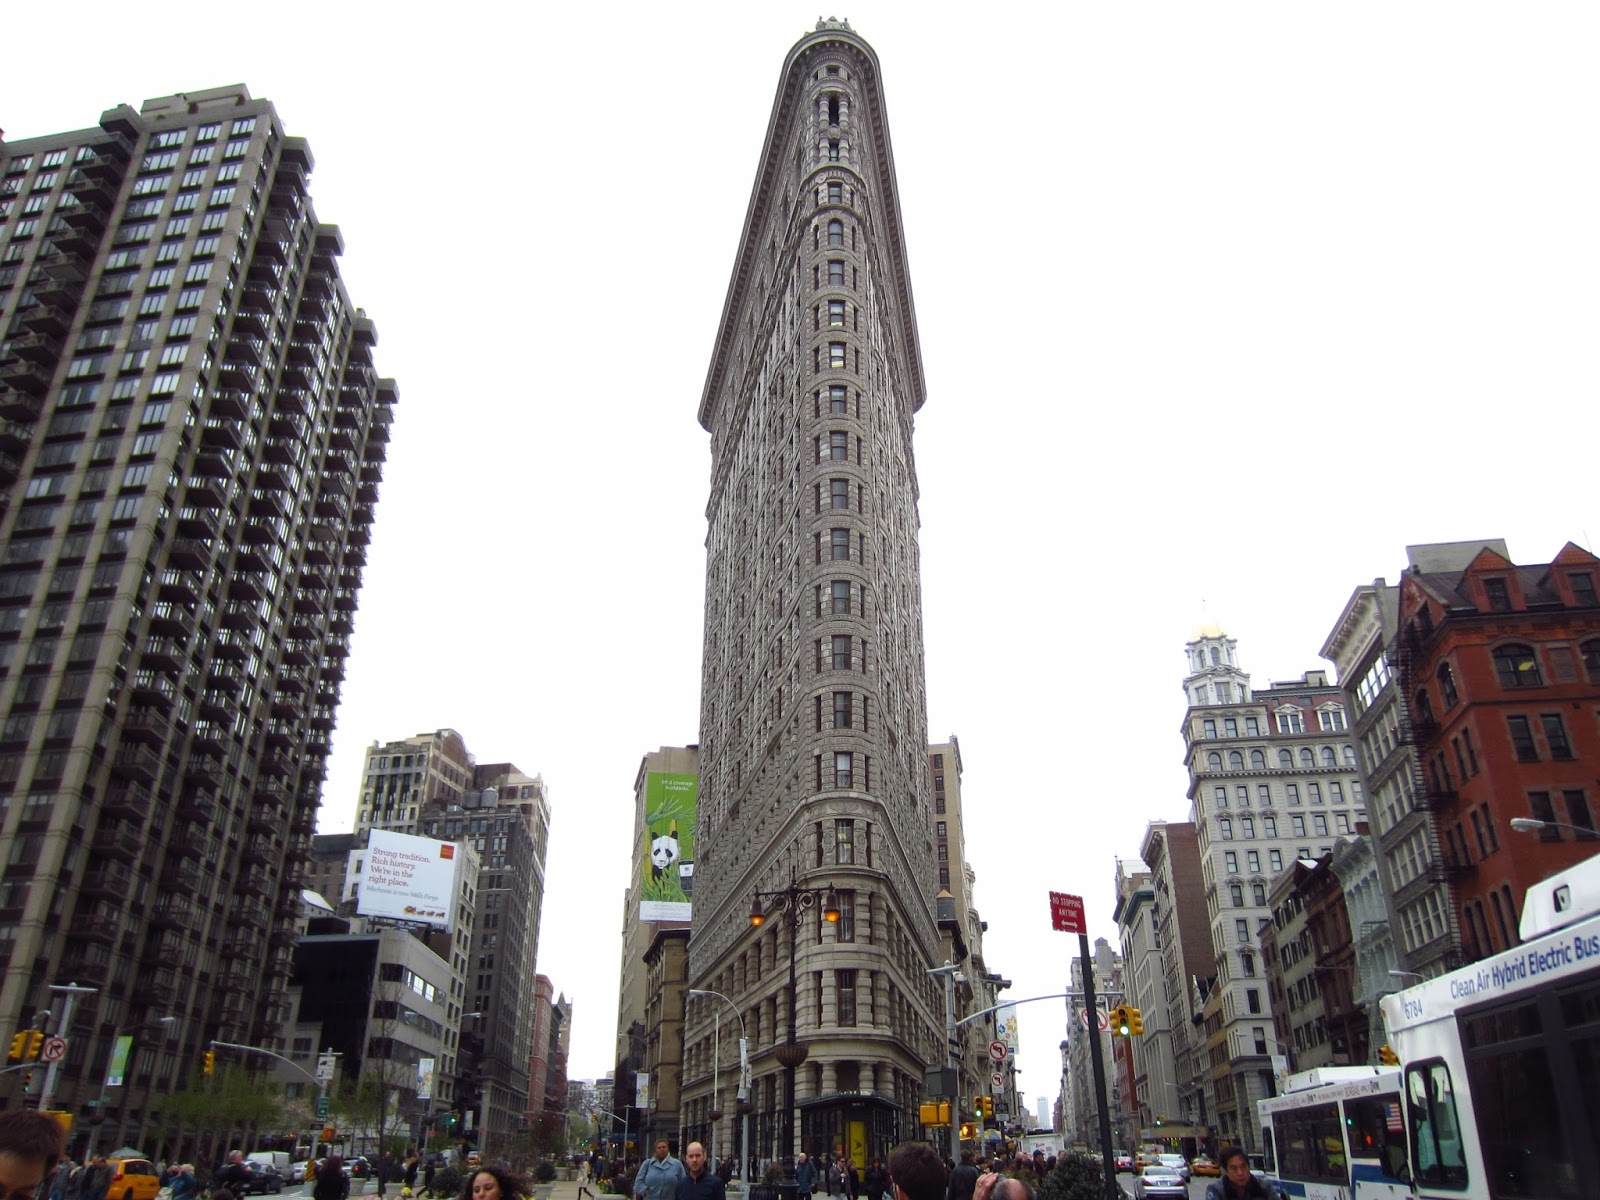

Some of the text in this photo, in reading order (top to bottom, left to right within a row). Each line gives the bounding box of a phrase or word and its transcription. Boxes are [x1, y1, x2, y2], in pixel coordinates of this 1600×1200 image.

[373, 847, 431, 863] Strong tradition.
[371, 856, 416, 870] Rich history.
[371, 865, 391, 875] We're
[401, 869, 413, 878] the
[368, 875, 409, 887] right place.
[409, 891, 424, 899] Wells
[424, 893, 439, 901] Fargo
[1060, 898, 1082, 908] STOPPING
[1058, 908, 1078, 918] ANYTIME
[1450, 934, 1600, 1000] Clean Air Hybrid Electric Bus
[1404, 999, 1424, 1020] 6784
